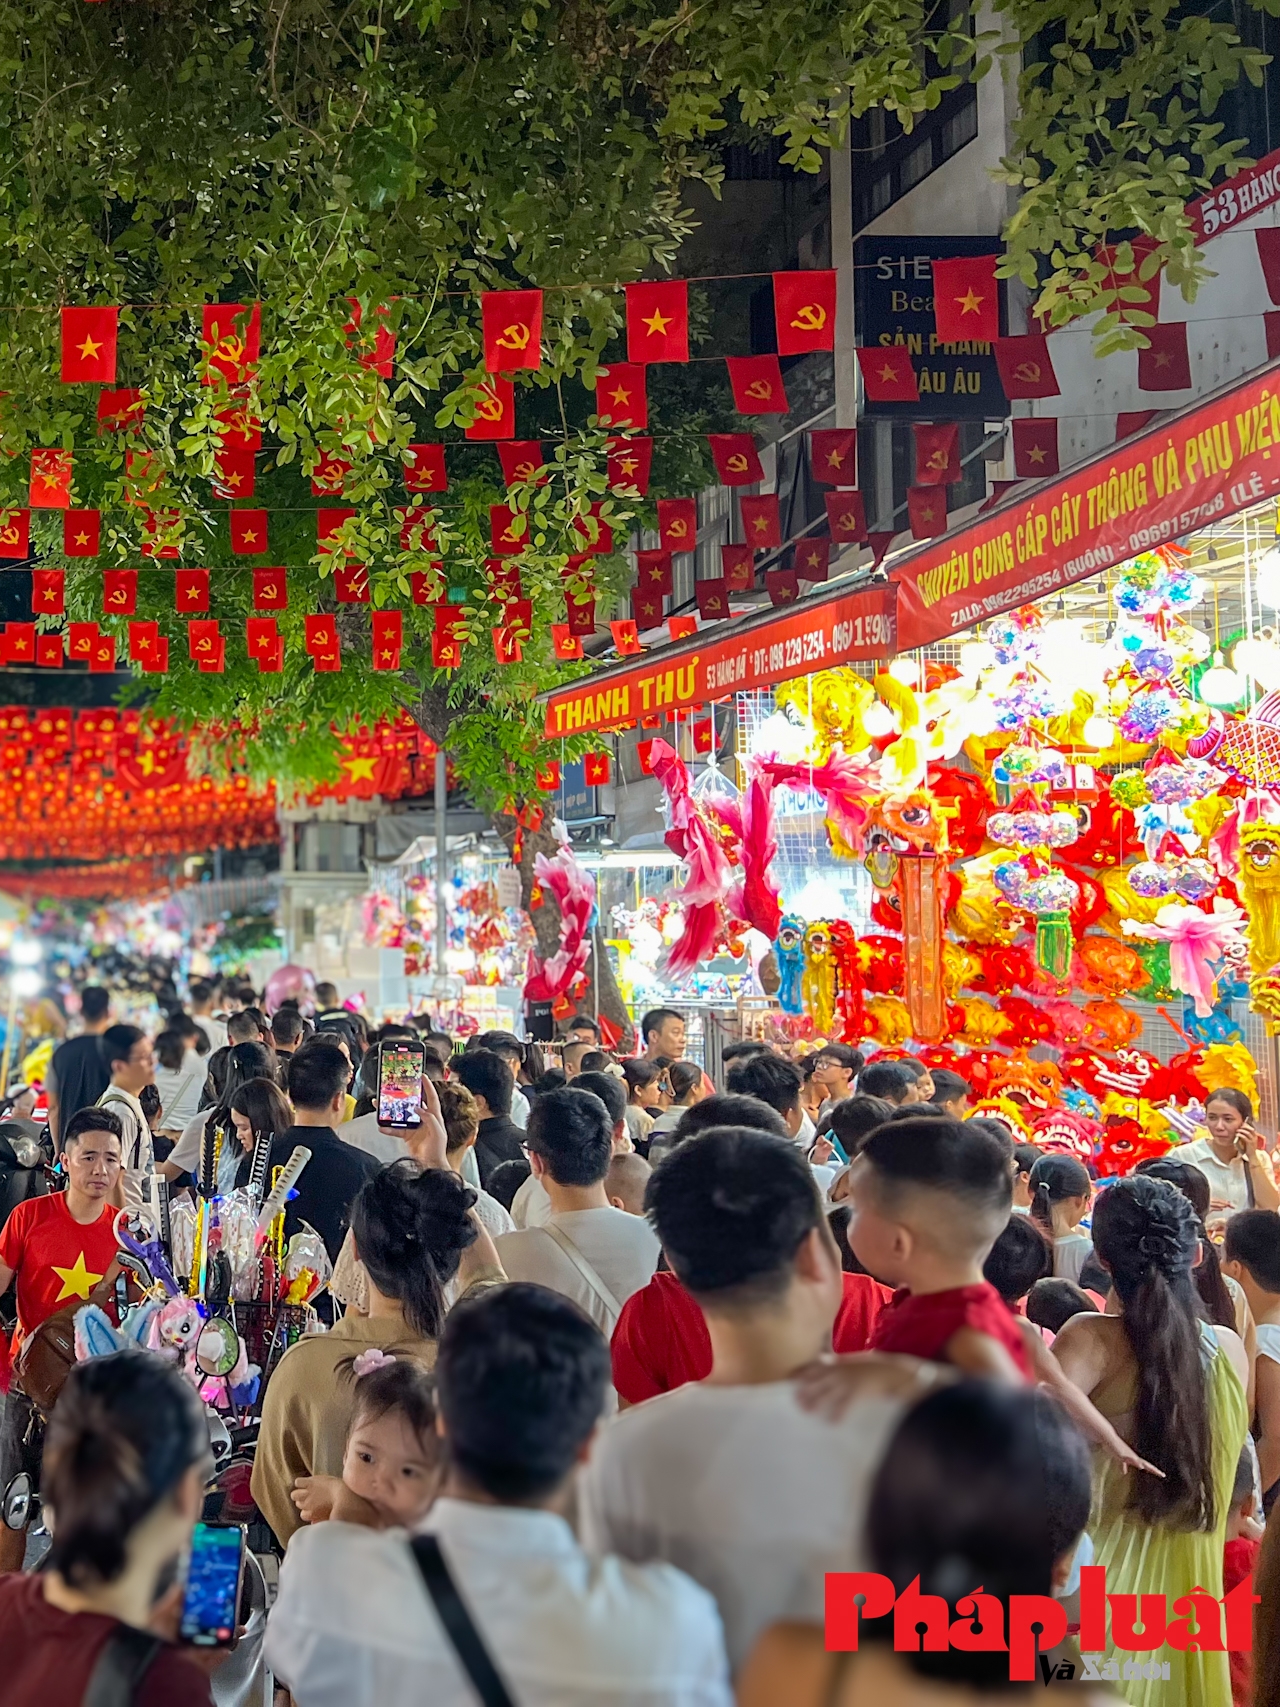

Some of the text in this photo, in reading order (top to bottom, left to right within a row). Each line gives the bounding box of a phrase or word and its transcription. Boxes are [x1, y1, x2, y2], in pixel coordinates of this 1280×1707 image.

[1201, 188, 1238, 235] 53
[876, 255, 932, 280] SIE
[891, 290, 936, 313] Bea
[953, 366, 981, 394] ÂU
[917, 549, 969, 609] CHUYÊN
[972, 531, 1015, 585] CUNG
[1015, 503, 1048, 564] CẤP
[1051, 492, 1082, 547] CÂY
[1087, 462, 1148, 530] THÔNG
[1152, 438, 1183, 499] VÀ
[1185, 420, 1233, 485] PHỤ
[951, 604, 984, 628] ZALO:
[982, 568, 1061, 612] 0982295254
[1063, 544, 1115, 581] (BUÔN)
[1230, 471, 1265, 506] (LẺ
[555, 685, 629, 732] THANH
[638, 655, 700, 709] THƯ
[706, 664, 716, 689] 53
[716, 654, 734, 687] HÀNG
